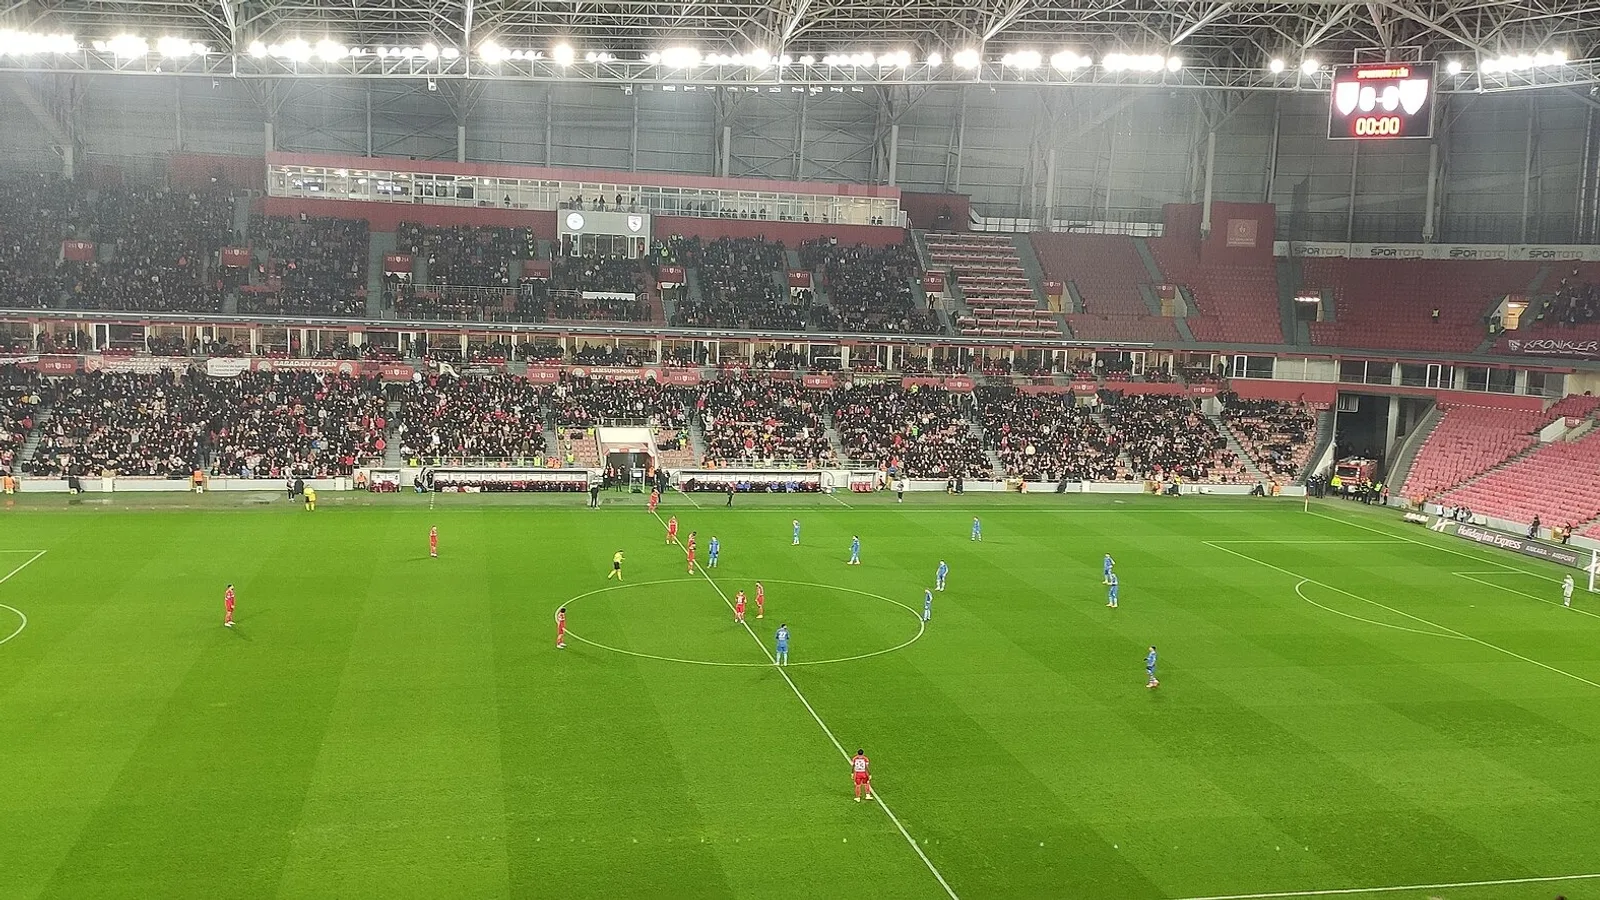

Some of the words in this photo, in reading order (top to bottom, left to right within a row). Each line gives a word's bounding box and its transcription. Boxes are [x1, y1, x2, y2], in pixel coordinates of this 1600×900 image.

[1355, 117, 1400, 136] 00:00
[1457, 525, 1483, 542] Holiday
[1494, 534, 1523, 550] Express
